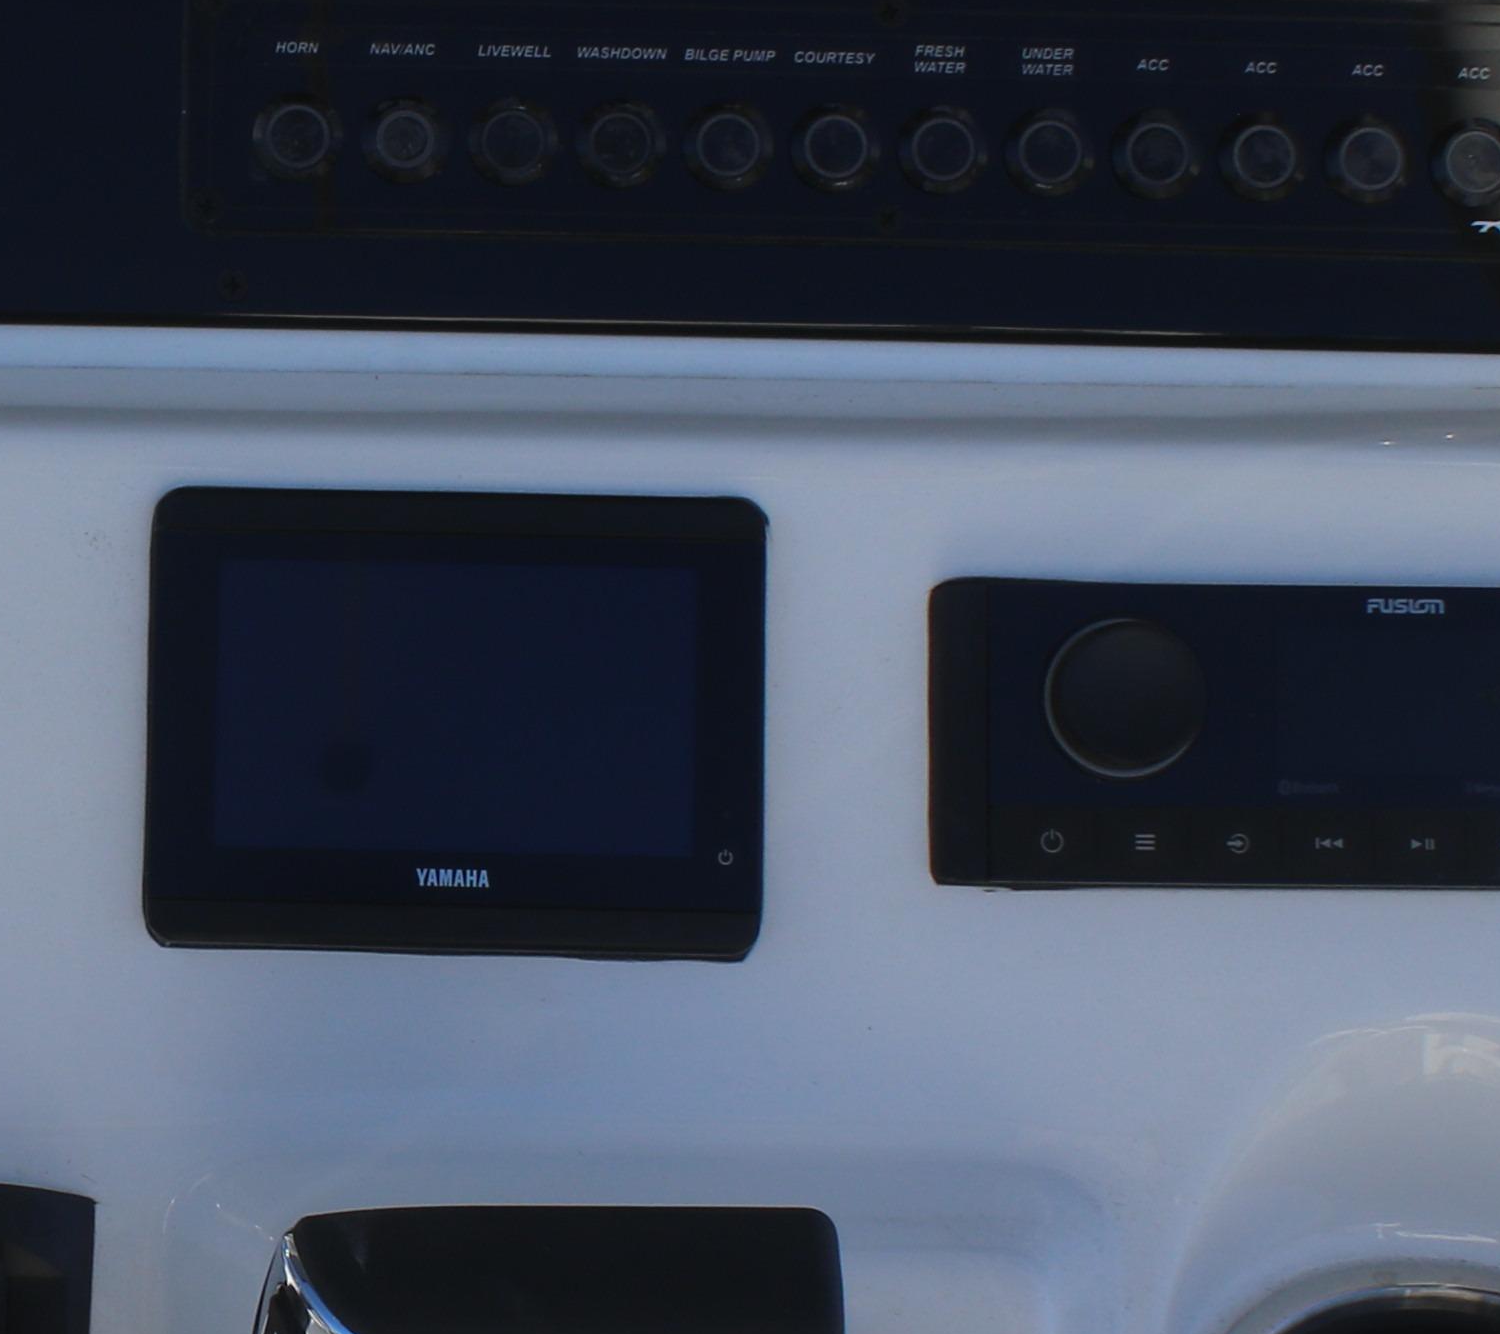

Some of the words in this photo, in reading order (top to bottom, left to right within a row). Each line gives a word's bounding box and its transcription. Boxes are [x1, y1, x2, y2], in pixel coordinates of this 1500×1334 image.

[275, 41, 320, 54] HORN
[477, 44, 552, 58] LIVEWELL
[576, 46, 668, 60] WASHDOWN
[914, 44, 966, 58] FRESH
[1021, 47, 1075, 60] UNDER
[684, 48, 730, 62] BILGE
[732, 49, 776, 63] PUMP
[793, 51, 876, 65] COURTESY
[913, 60, 967, 74] WATER
[1021, 63, 1074, 76] WATER
[1137, 58, 1170, 71] ACC
[1244, 60, 1278, 74] ACC
[1351, 63, 1385, 77] ACC
[1457, 66, 1491, 80] ACC
[1366, 598, 1446, 616] FUSION
[416, 867, 490, 889] YAMAHA
